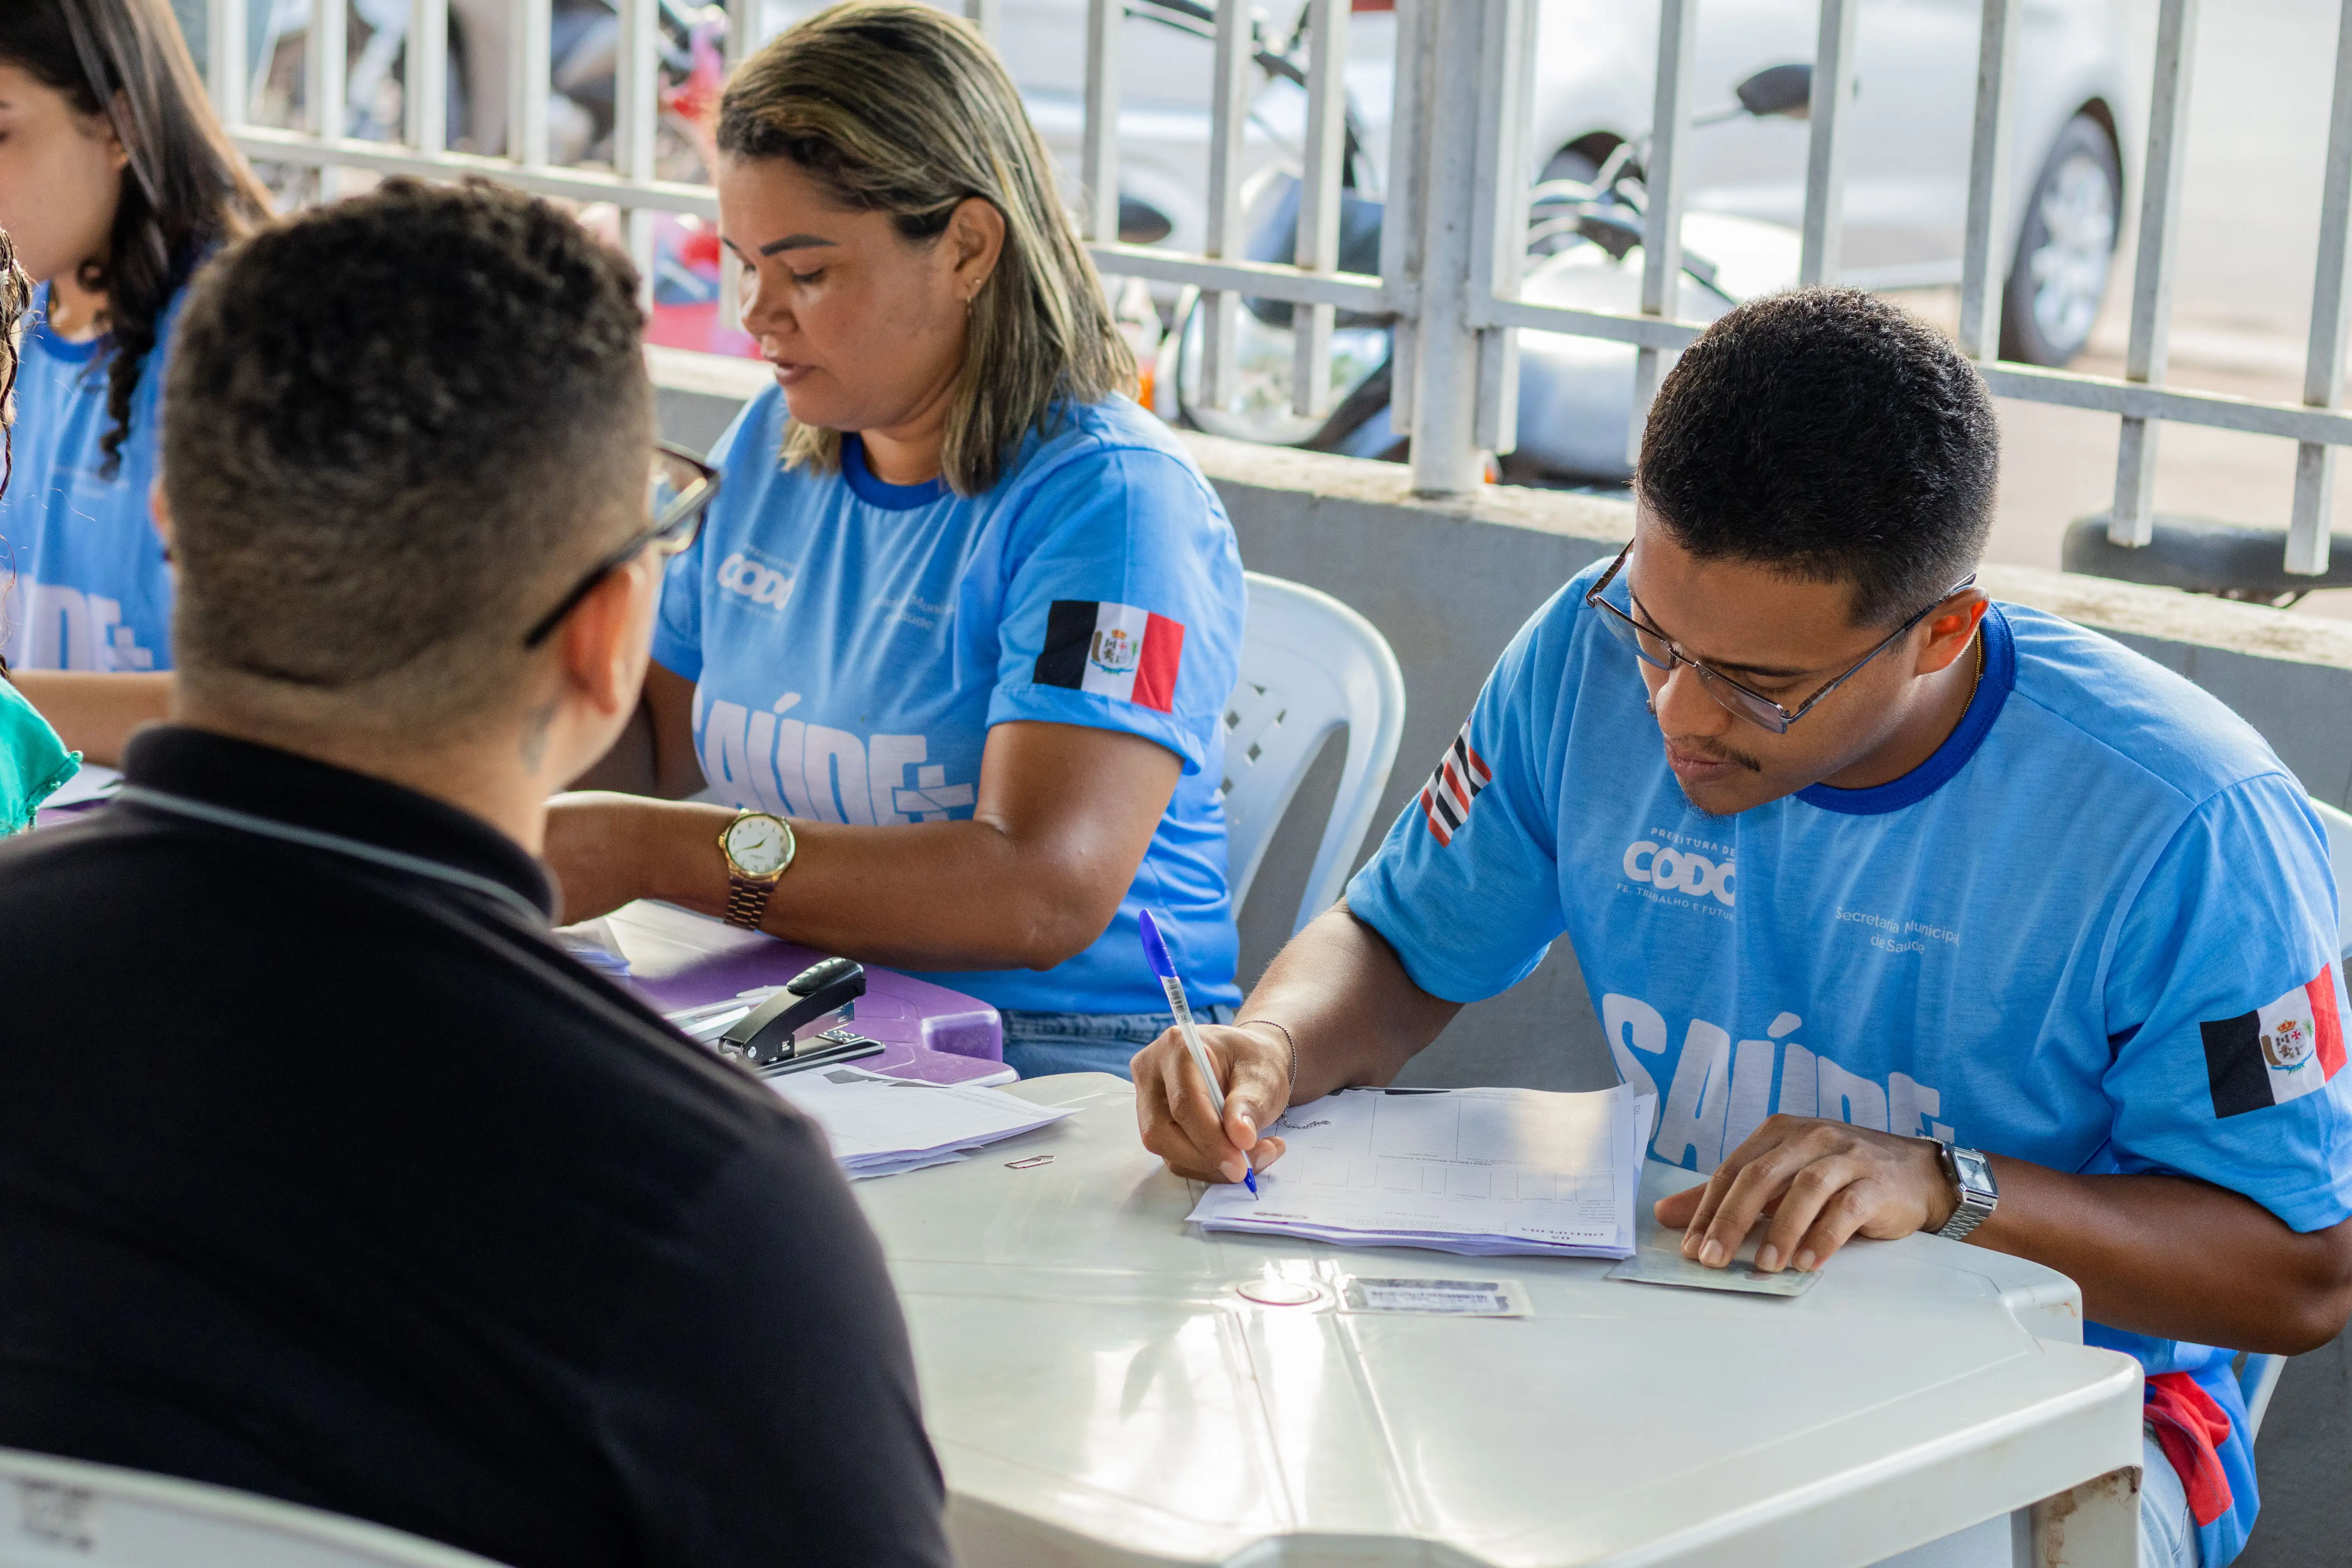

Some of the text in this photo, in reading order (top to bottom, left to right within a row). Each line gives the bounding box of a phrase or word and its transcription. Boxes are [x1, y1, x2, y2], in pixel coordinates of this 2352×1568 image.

[1637, 887, 1690, 908] TRABALHO
[1835, 906, 1960, 946] Secretaria Municipal
[1871, 934, 1885, 948] de
